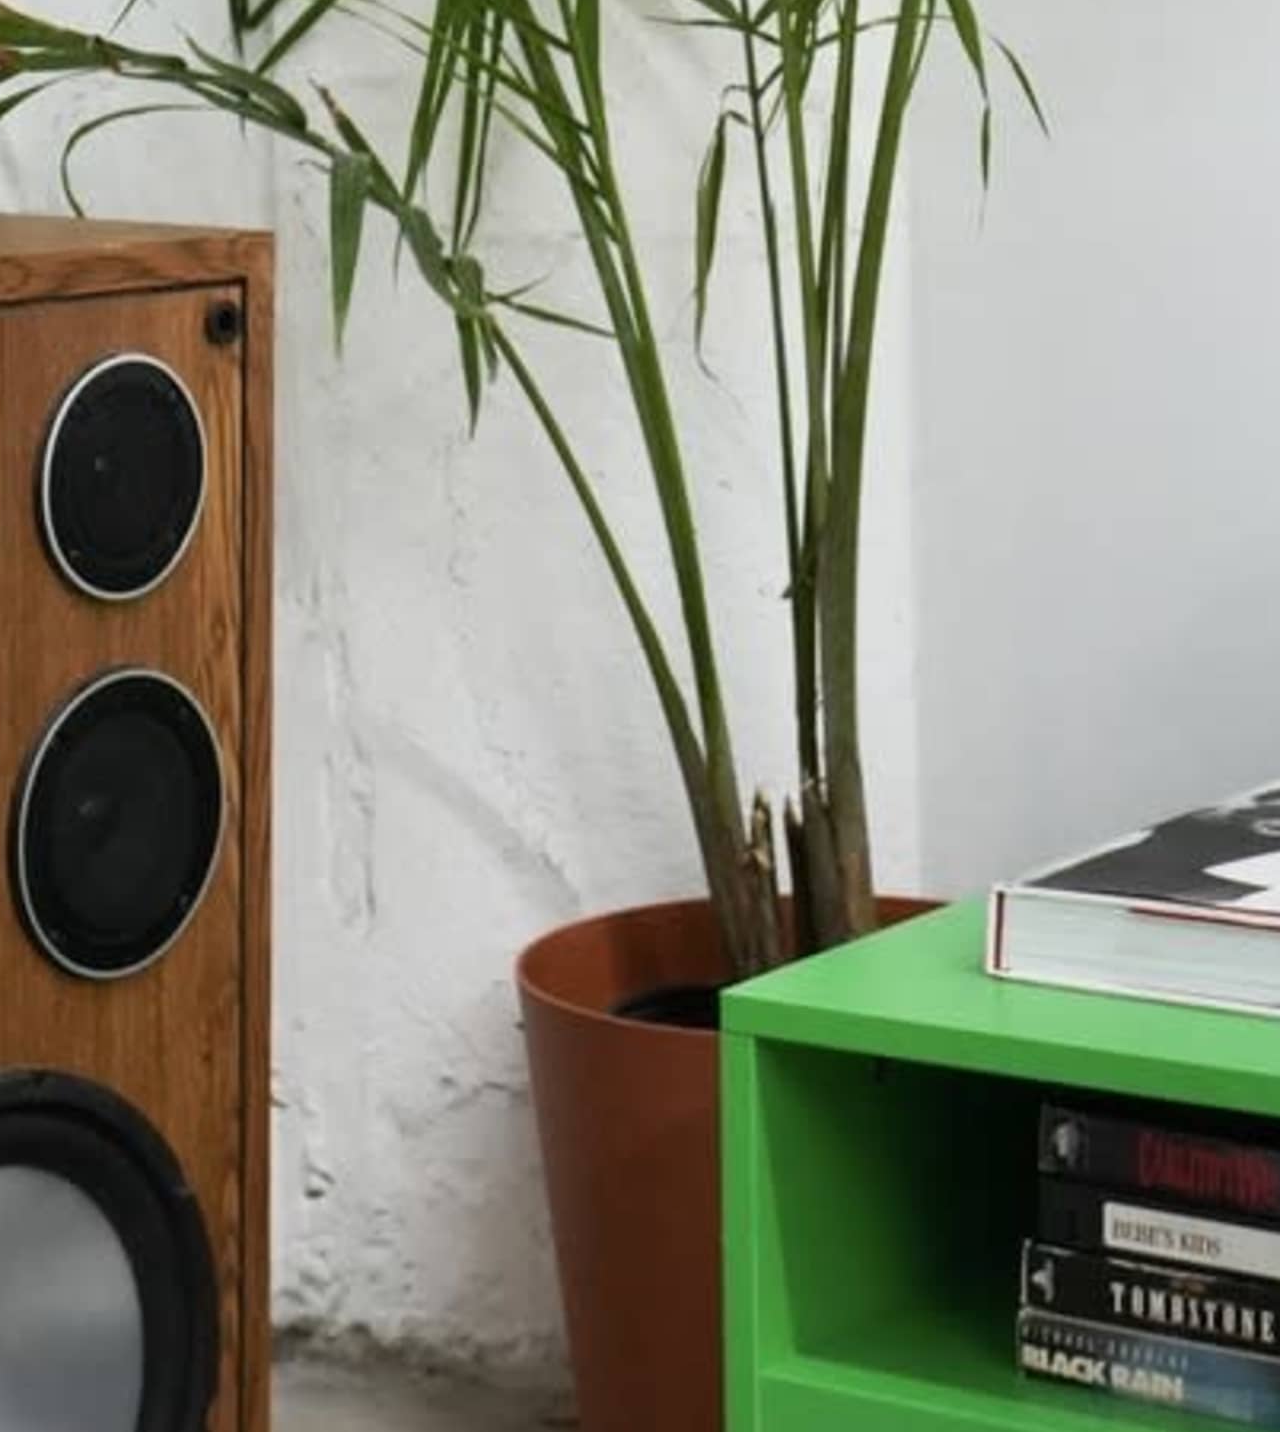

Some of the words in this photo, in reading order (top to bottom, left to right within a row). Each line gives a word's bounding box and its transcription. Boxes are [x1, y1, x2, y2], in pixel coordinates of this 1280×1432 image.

[1109, 1281, 1276, 1344] TOMBSTONE
[1021, 1343, 1108, 1385] BLACK
[1110, 1363, 1185, 1402] RAIN
